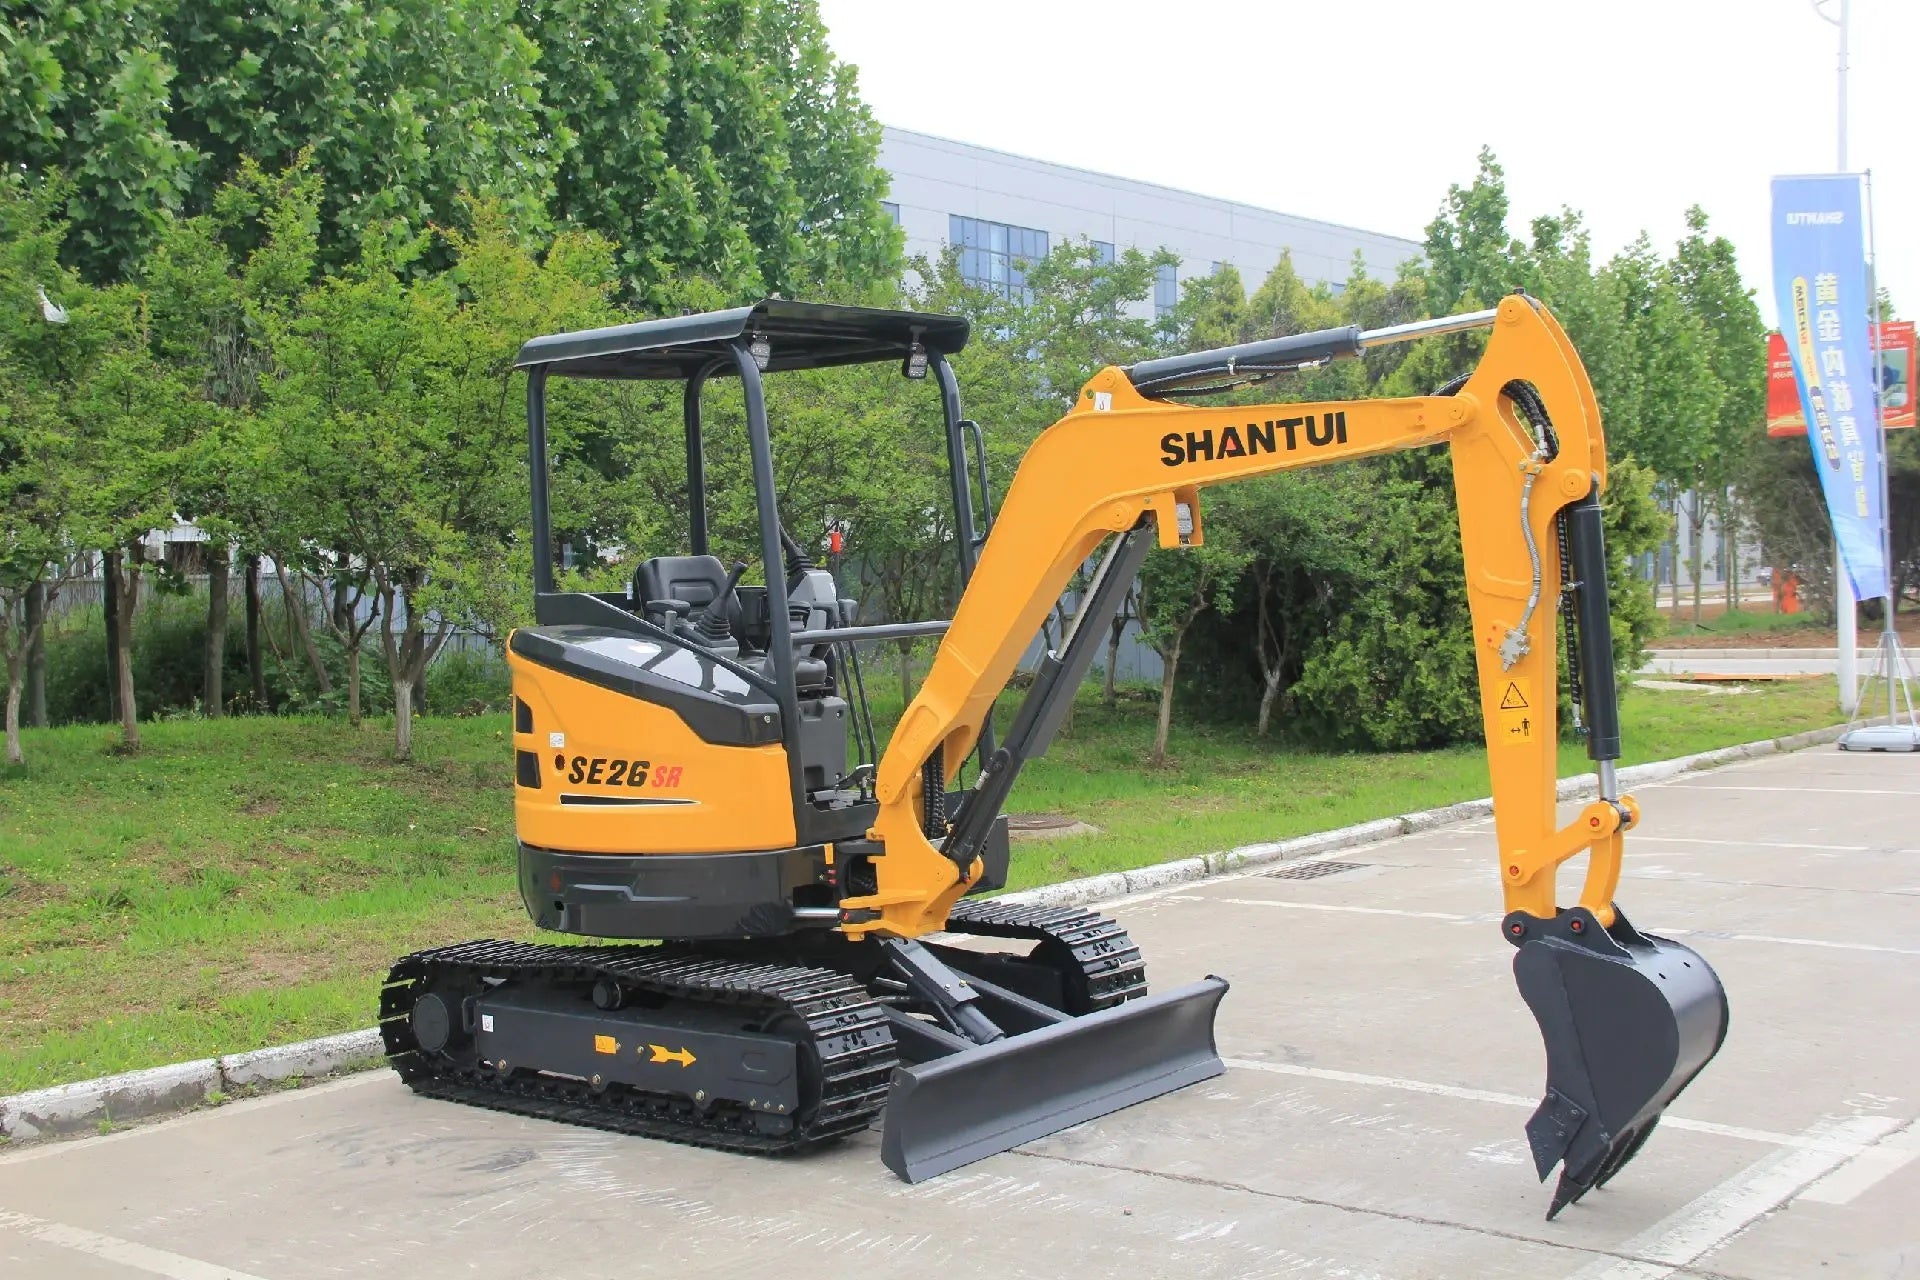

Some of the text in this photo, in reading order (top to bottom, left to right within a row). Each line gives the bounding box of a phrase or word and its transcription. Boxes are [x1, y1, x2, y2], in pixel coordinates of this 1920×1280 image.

[1160, 411, 1348, 467] SHANTUI
[568, 756, 682, 788] SE26 SR
